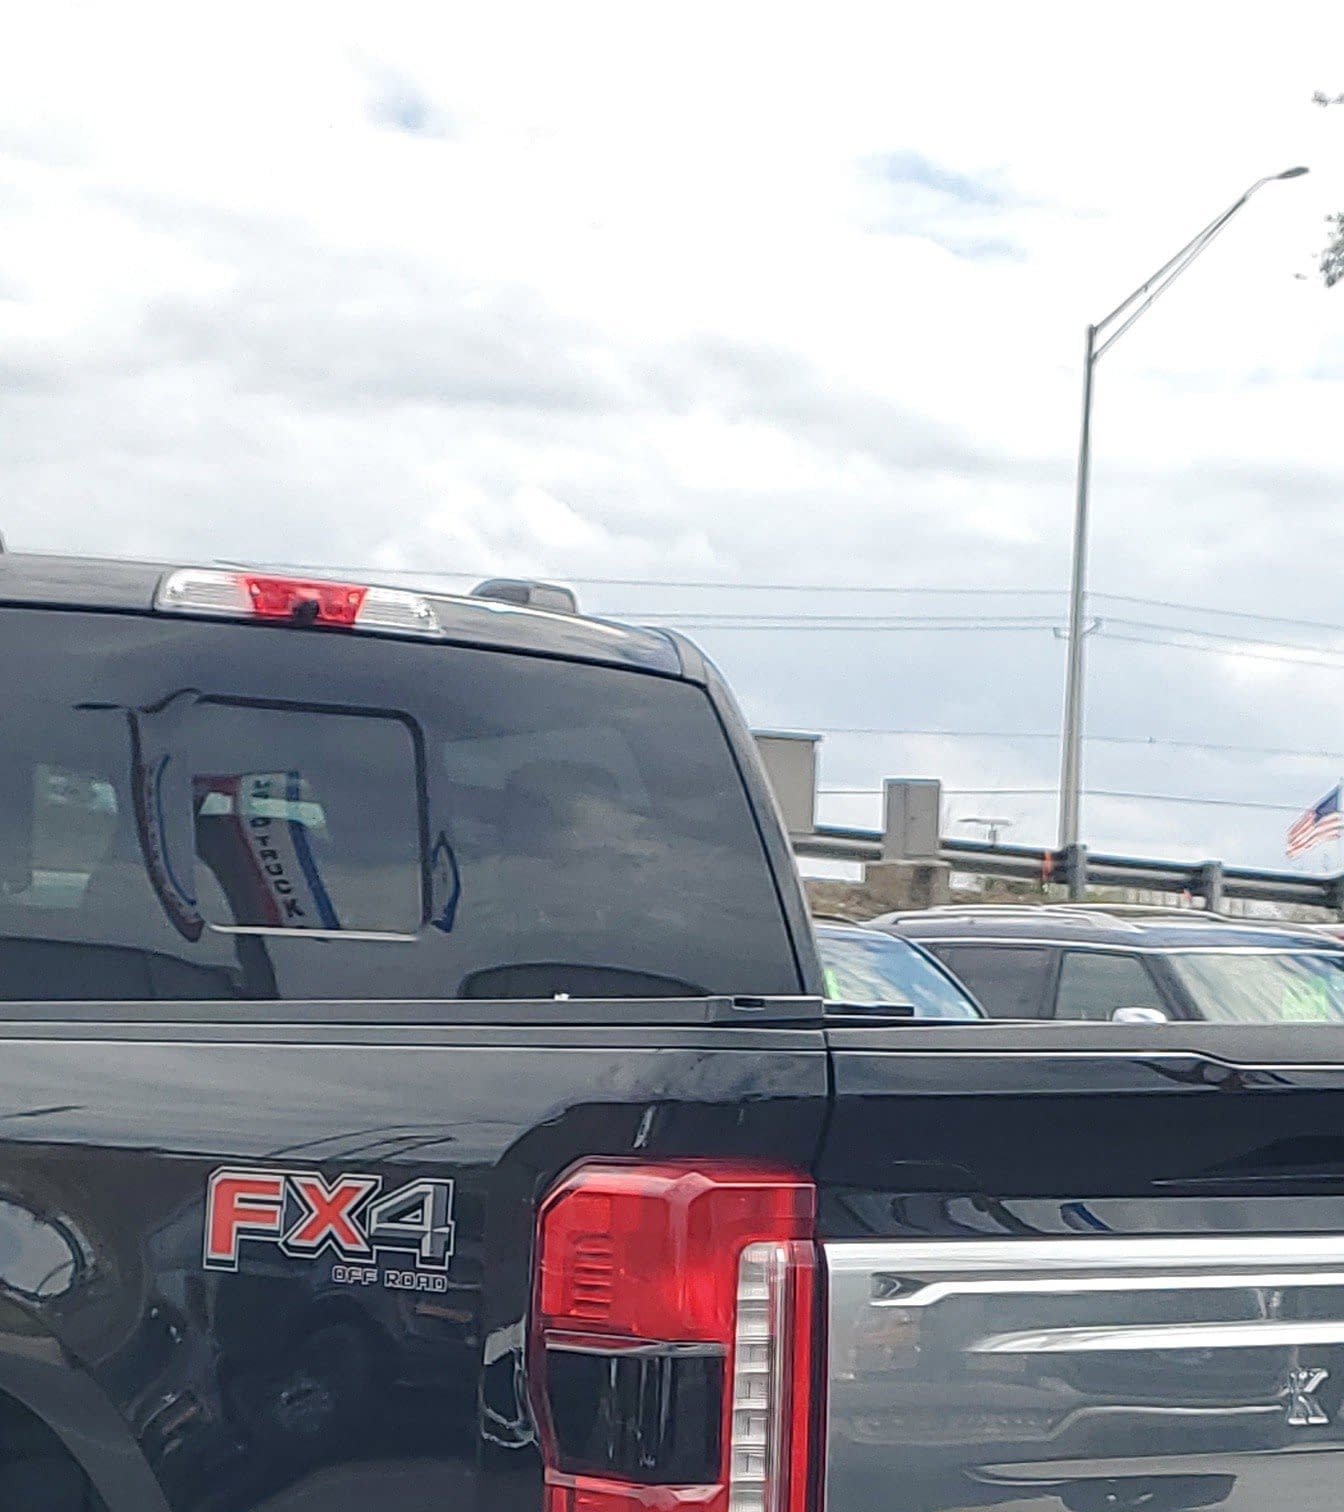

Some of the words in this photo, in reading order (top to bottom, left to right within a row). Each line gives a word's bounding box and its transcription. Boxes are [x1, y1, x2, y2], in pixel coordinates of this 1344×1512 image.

[203, 1166, 456, 1272] FX4
[332, 1266, 378, 1286] OFF
[384, 1270, 448, 1293] ROAD
